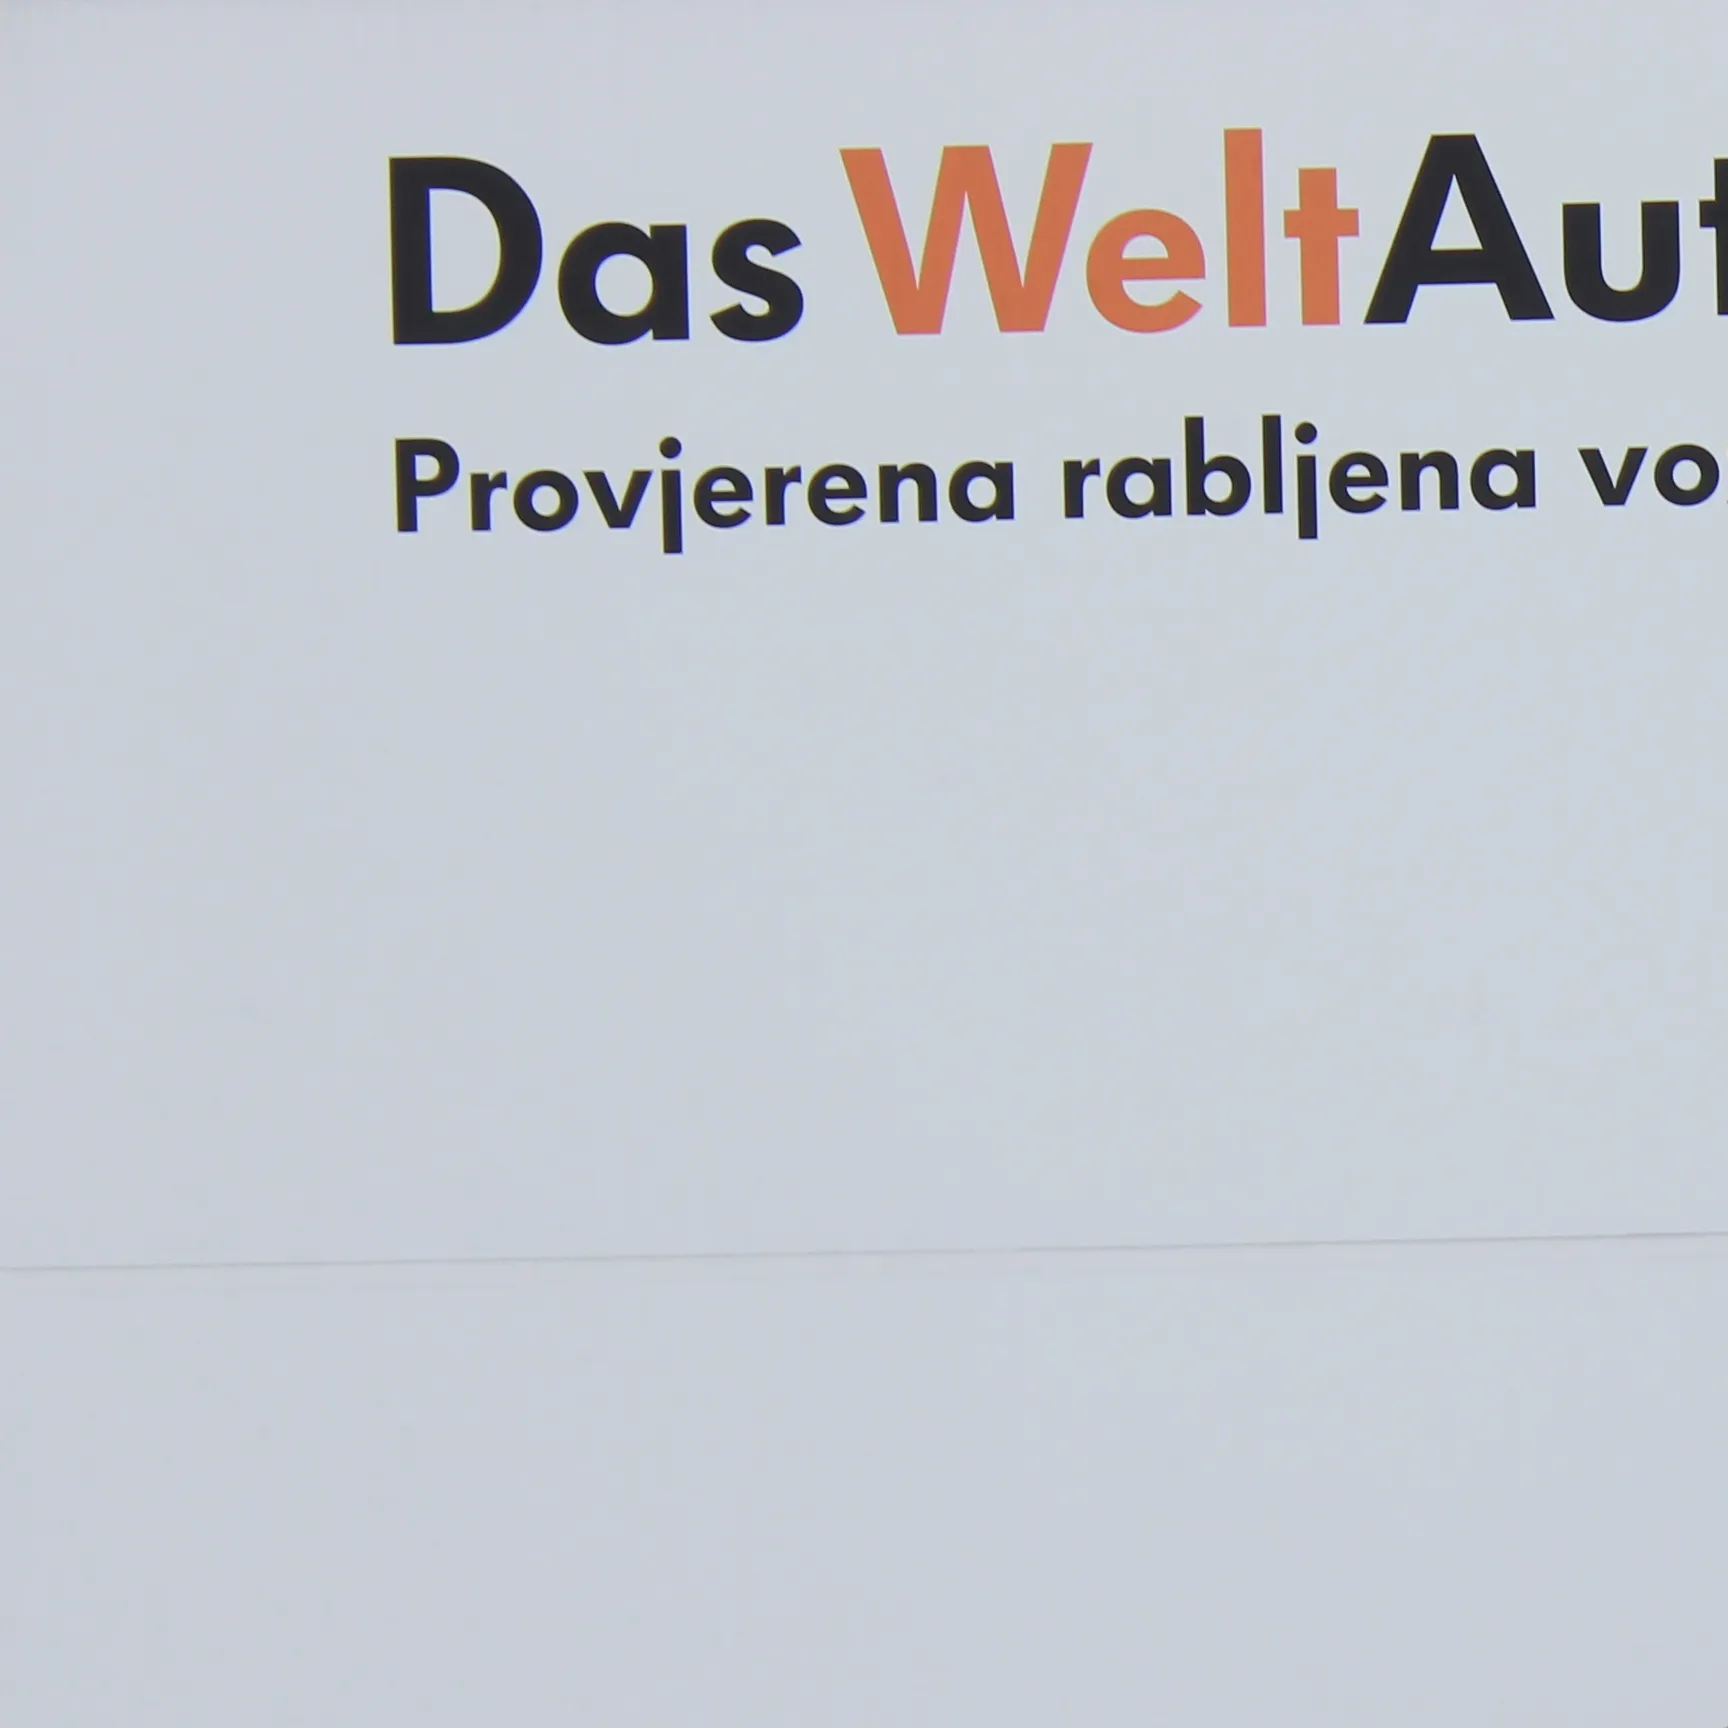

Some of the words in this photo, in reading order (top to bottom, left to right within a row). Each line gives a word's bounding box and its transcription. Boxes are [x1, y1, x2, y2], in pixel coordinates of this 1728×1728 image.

[388, 154, 805, 347] Das
[393, 435, 1016, 556] Provjerena
[1062, 412, 1538, 541] rabljena
